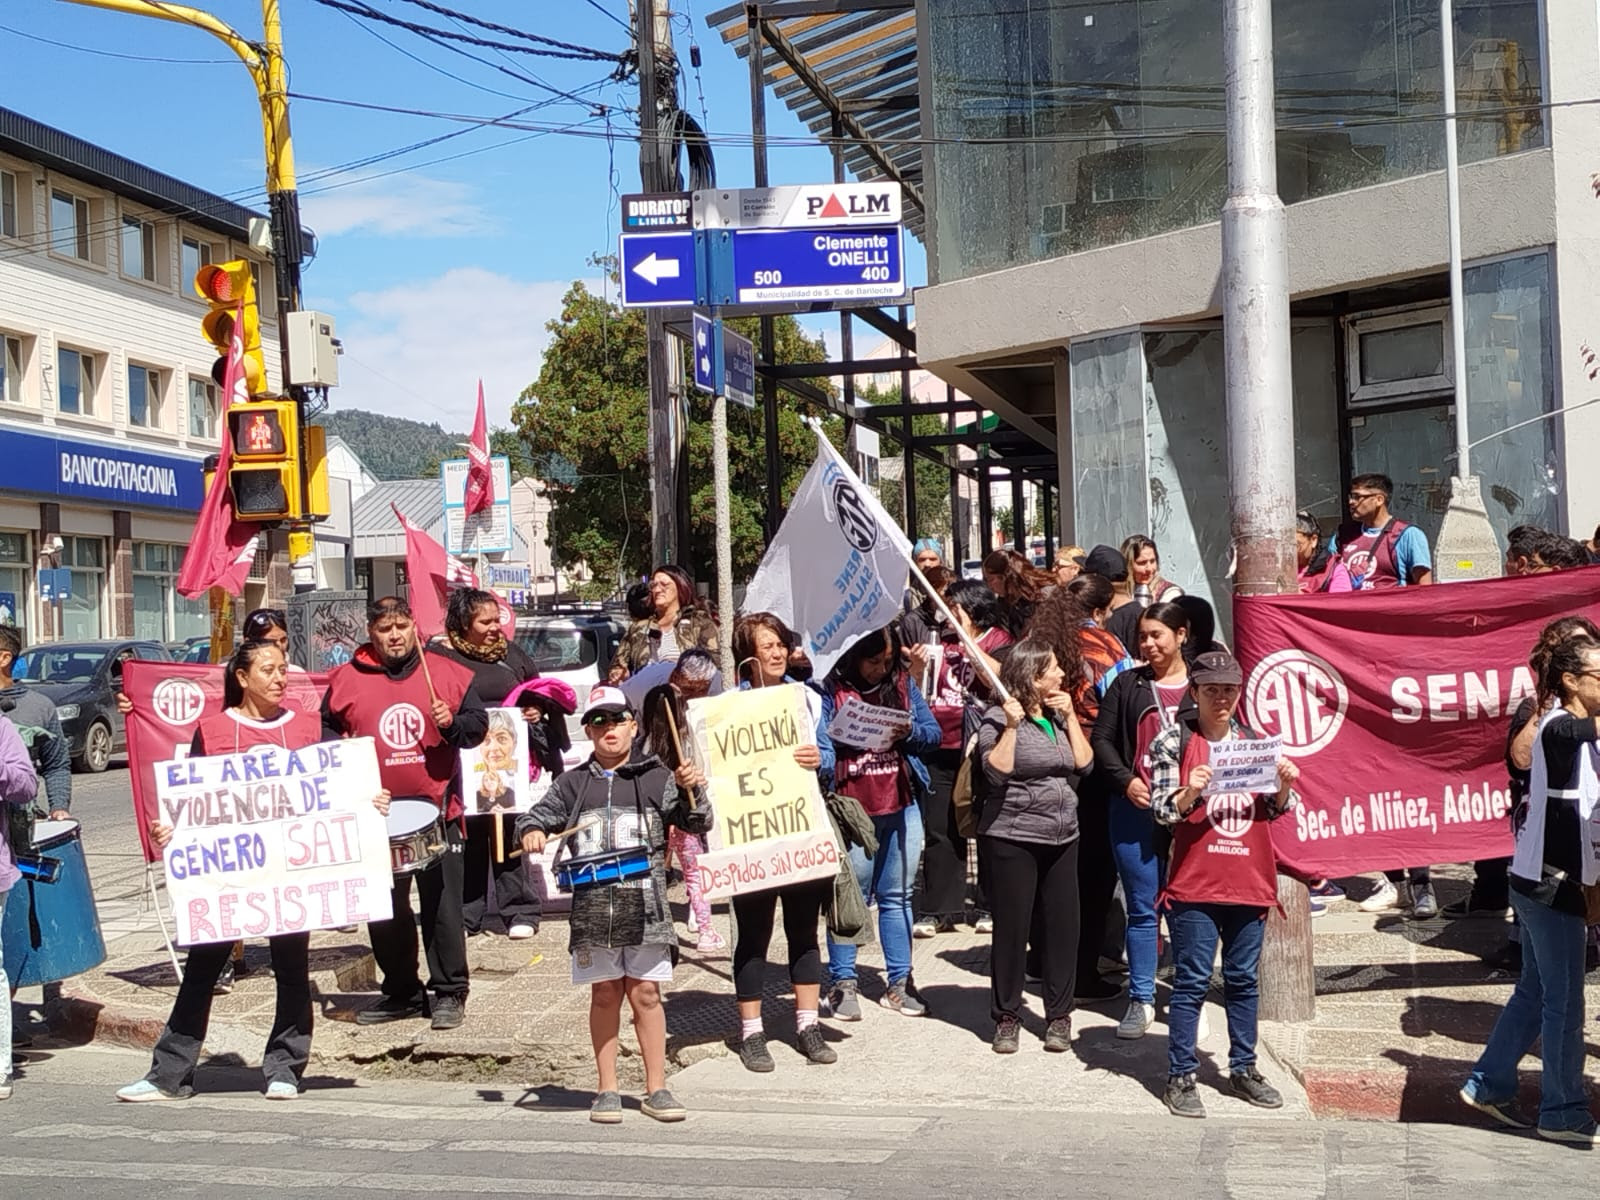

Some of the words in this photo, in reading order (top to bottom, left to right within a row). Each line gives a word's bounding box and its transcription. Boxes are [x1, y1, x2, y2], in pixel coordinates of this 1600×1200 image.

[629, 199, 690, 216] DURATOP
[814, 234, 888, 250] Clemente
[828, 250, 888, 266] ONELLI
[754, 270, 782, 285] 500
[861, 266, 890, 280] 400
[756, 289, 811, 300] Municipalidad
[812, 288, 822, 297] de
[824, 288, 832, 297] S.
[834, 288, 843, 296] C.
[844, 287, 854, 295] de
[856, 286, 893, 295] Bariloche
[158, 683, 200, 721] ATE
[1255, 660, 1333, 746] ATE
[1233, 744, 1247, 752] LOS
[167, 761, 203, 787] EL
[318, 744, 342, 768] DE
[300, 777, 331, 812] DE
[737, 767, 774, 797] ES
[1295, 801, 1337, 842] Sec.
[1341, 797, 1365, 836] de
[1370, 790, 1438, 835] Niñez,
[288, 816, 354, 866] SAT
[188, 878, 370, 942] RESISTE
